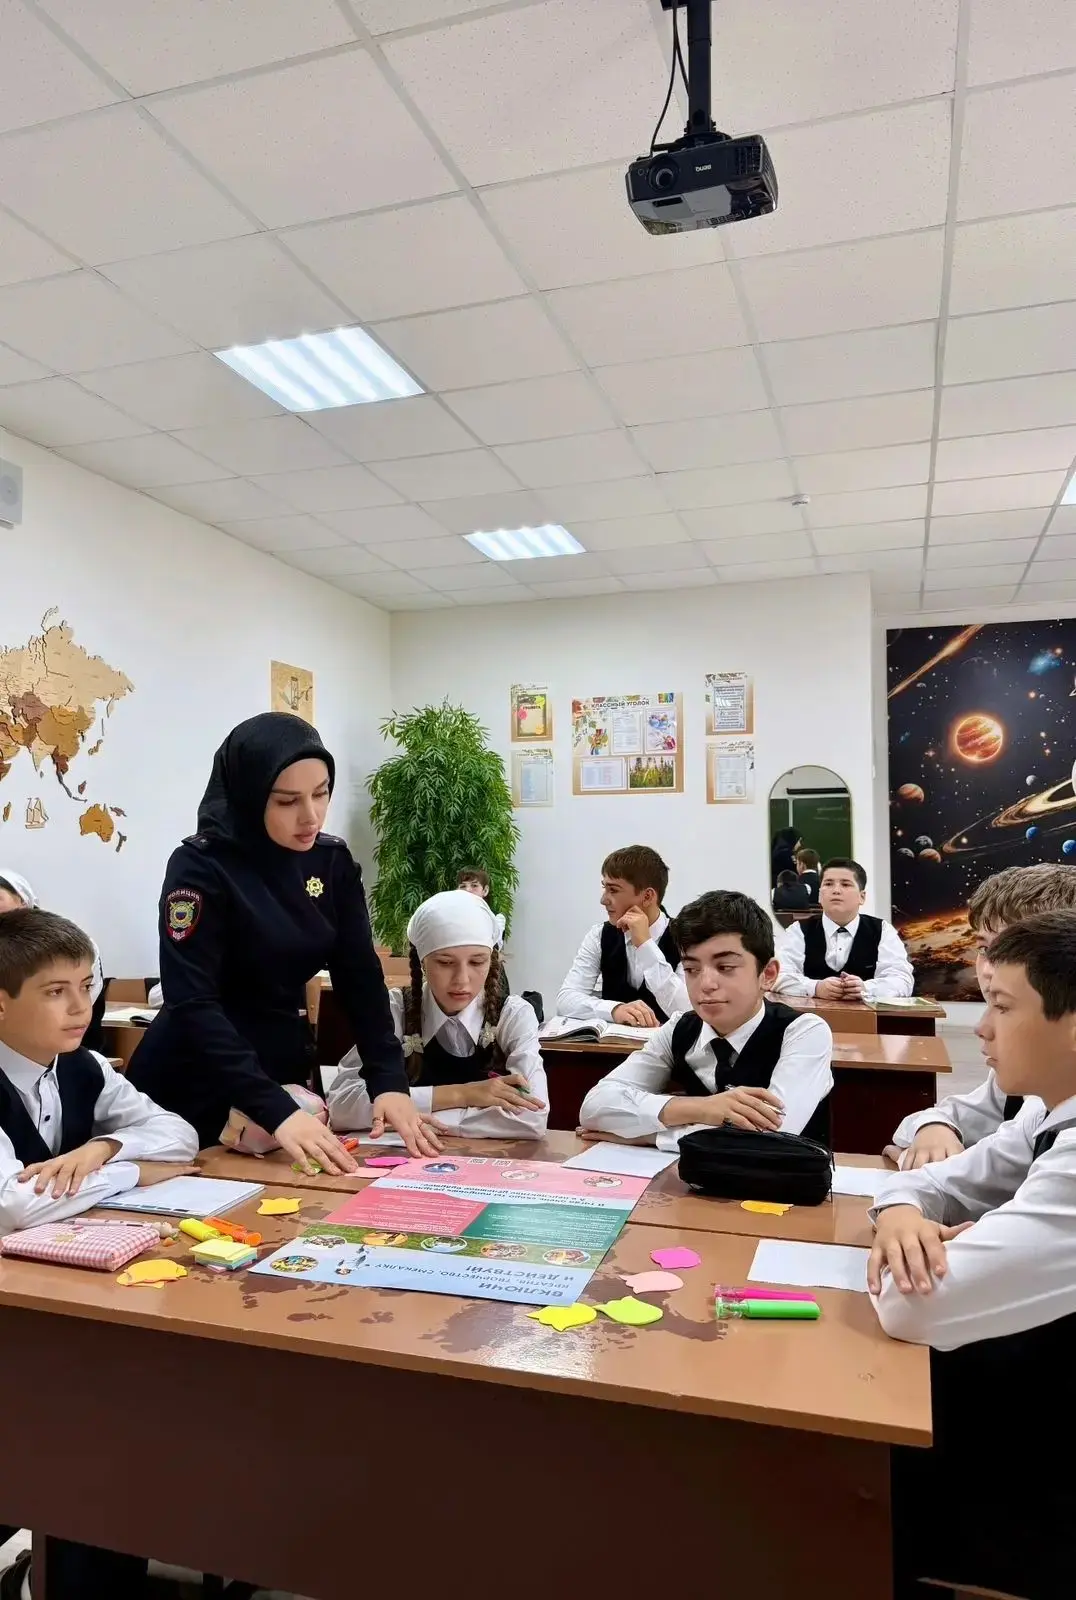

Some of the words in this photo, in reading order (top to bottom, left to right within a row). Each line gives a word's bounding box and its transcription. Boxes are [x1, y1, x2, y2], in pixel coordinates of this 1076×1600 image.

[374, 1263, 434, 1275] СМЕКАЛКУ
[465, 1265, 560, 1281] ДЕЙСТВУЙ!
[479, 1282, 564, 1298] ВКЛЮЧИ
